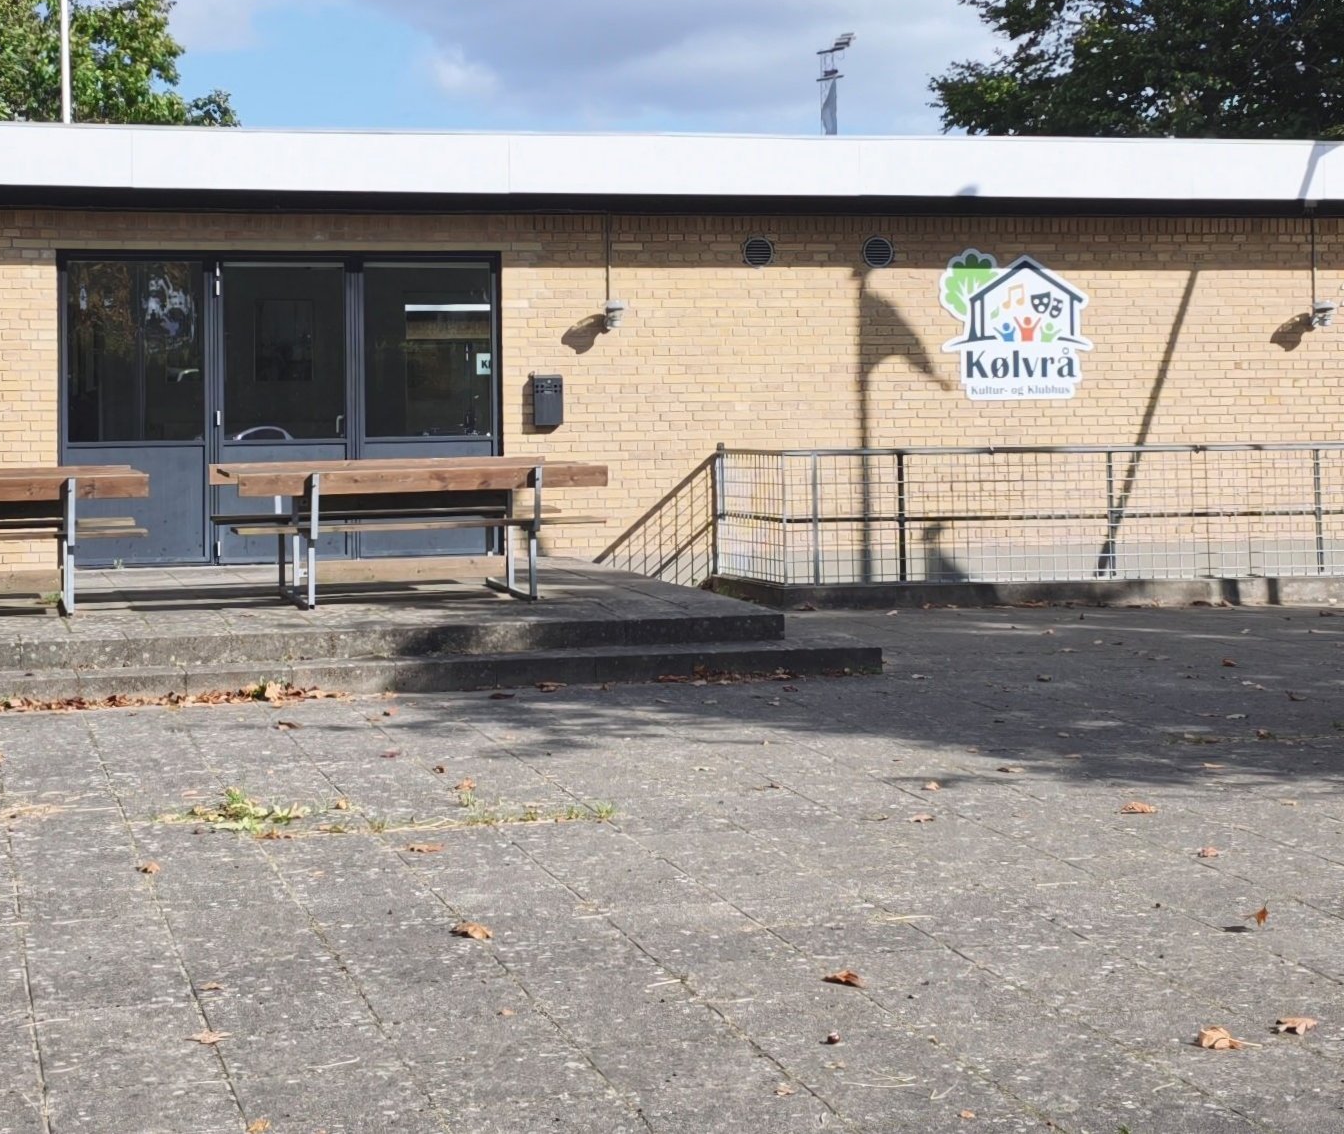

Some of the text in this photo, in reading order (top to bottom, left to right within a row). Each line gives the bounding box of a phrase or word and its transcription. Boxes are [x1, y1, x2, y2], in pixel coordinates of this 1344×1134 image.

[966, 347, 1076, 379] Kølvrå
[971, 385, 1071, 397] Kultur- og Klubhus
